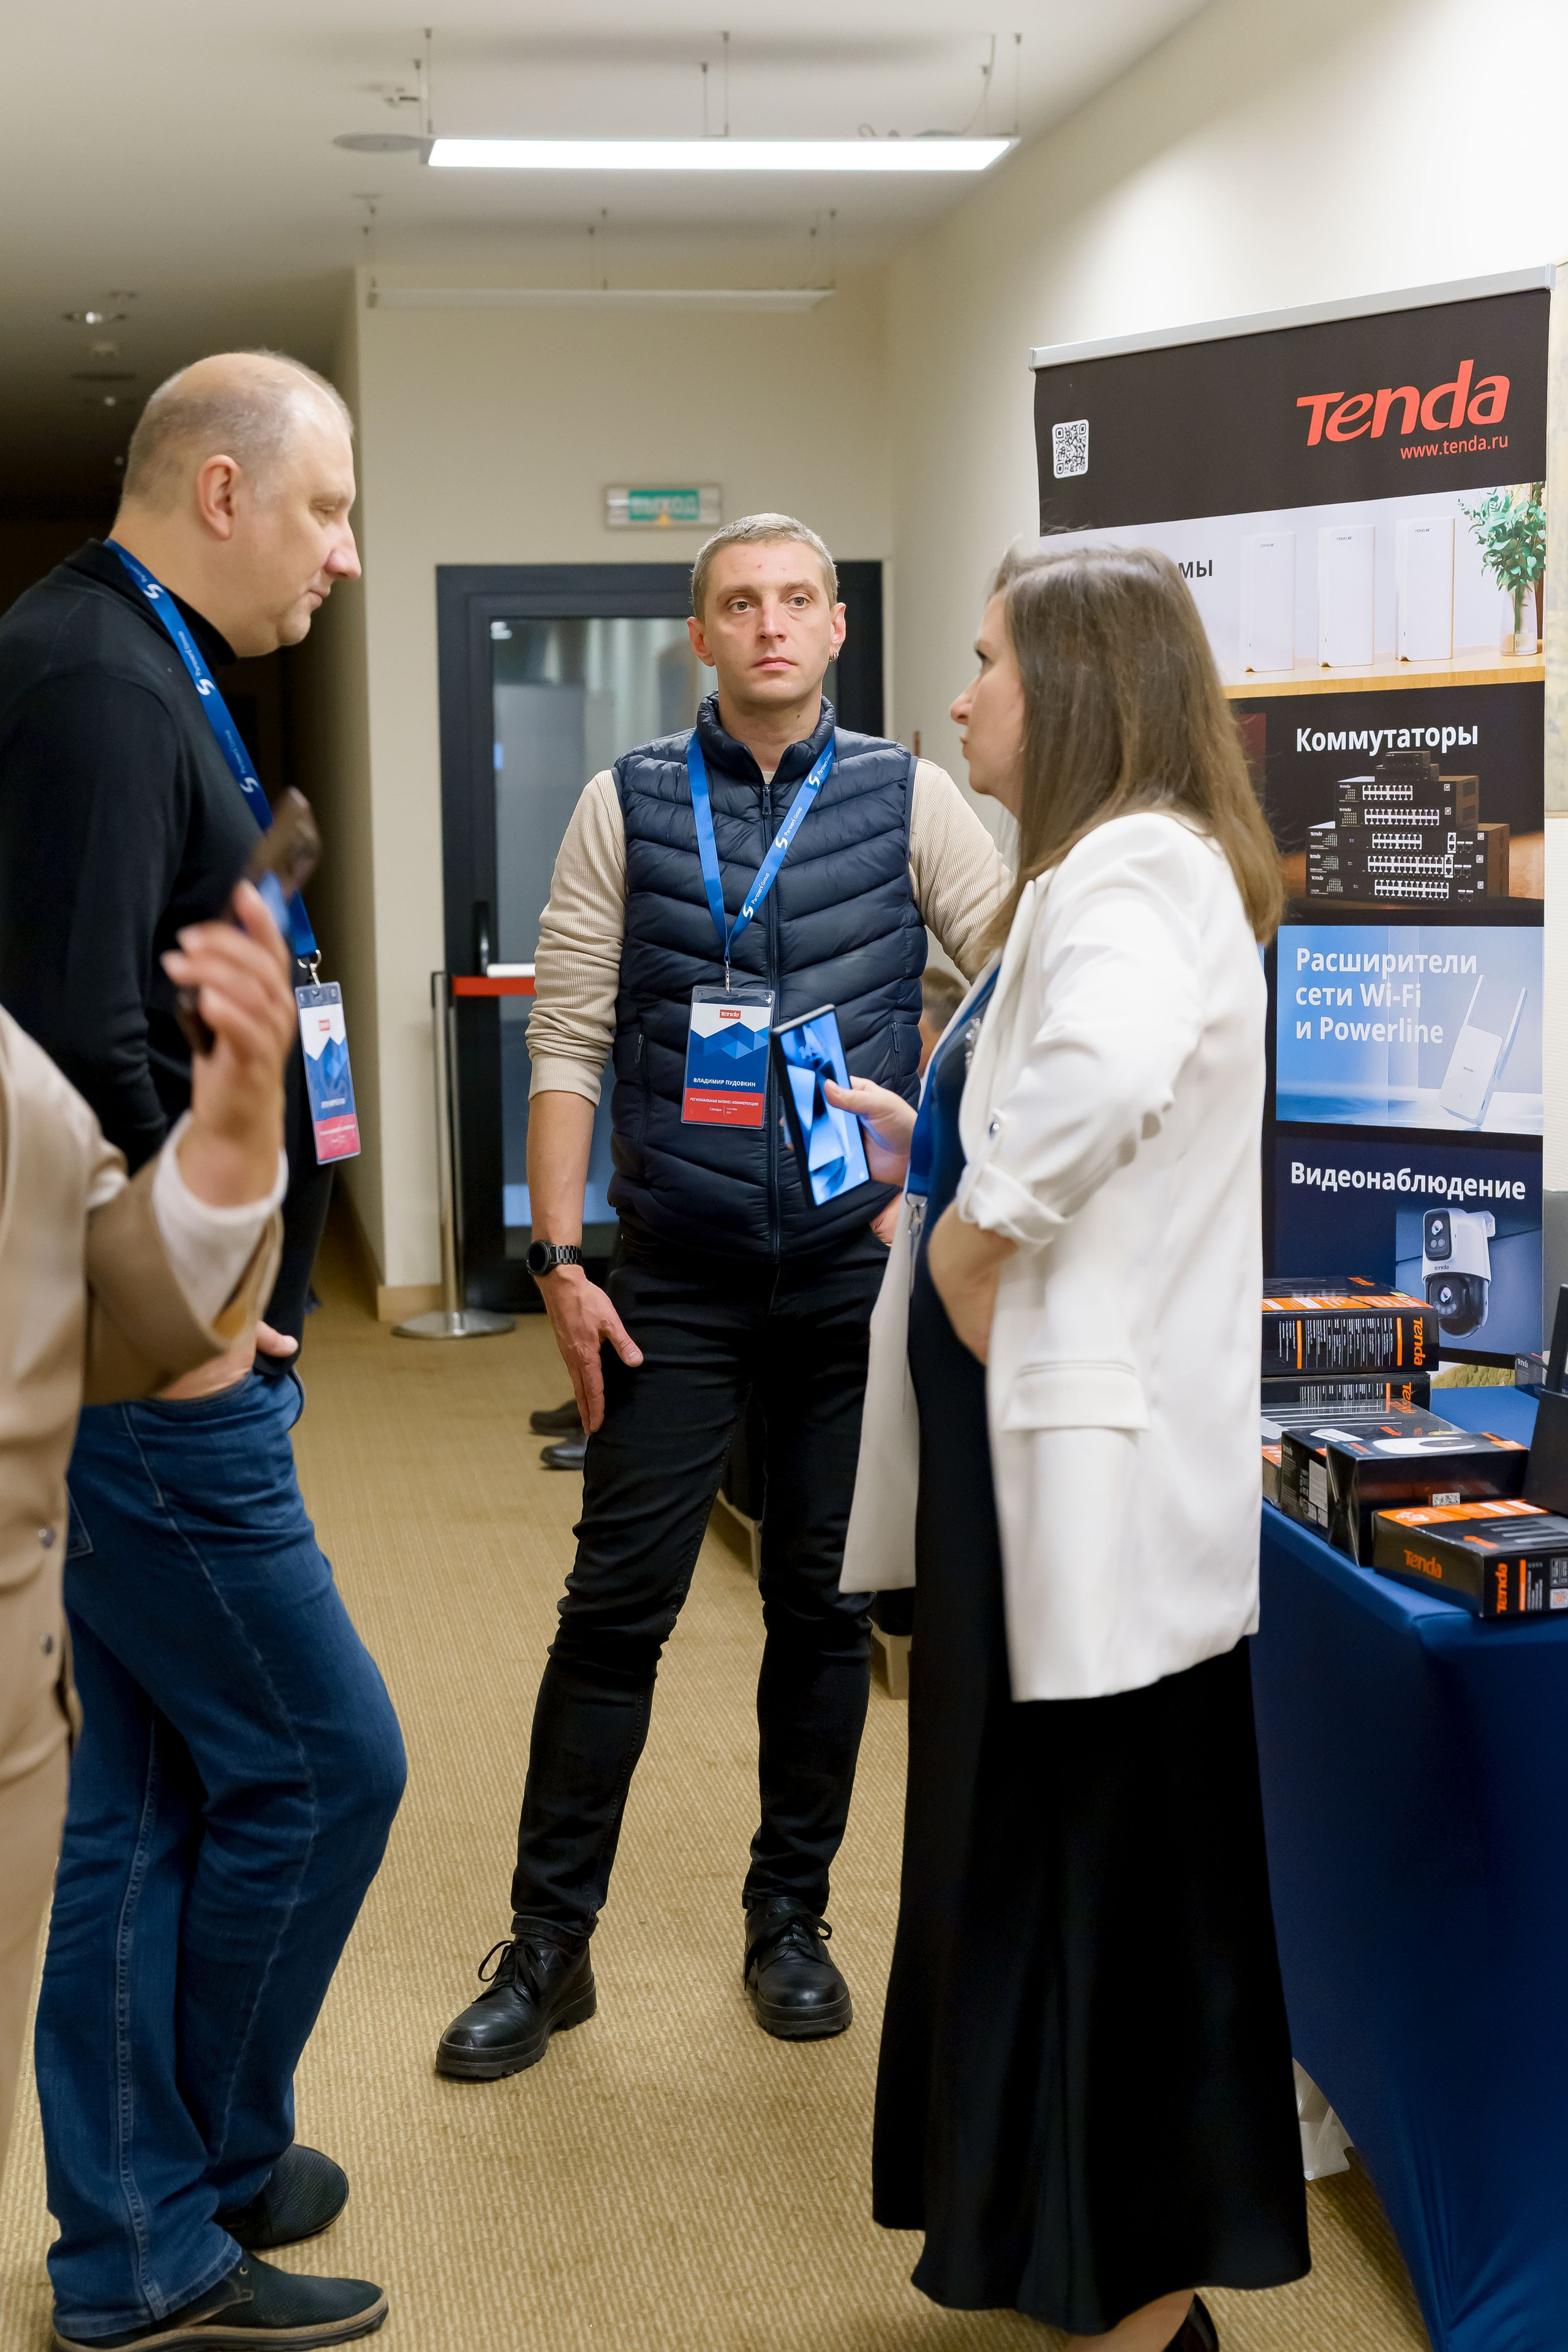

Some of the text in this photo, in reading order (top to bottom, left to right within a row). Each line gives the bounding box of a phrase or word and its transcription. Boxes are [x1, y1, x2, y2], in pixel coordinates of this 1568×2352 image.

[1297, 359, 1510, 446] Tenda
[1400, 435, 1509, 459] www.tenda.ru
[1297, 725, 1478, 756] Коммутаторы
[761, 872, 771, 886] Group
[1297, 948, 1477, 980] Расширители
[1295, 982, 1421, 1008] сети Wi-Fi
[1296, 1016, 1444, 1044] и Powerline
[1291, 1162, 1526, 1201] Видеонаблюдение
[1413, 1317, 1426, 1366] Tenda
[1404, 1550, 1442, 1578] Tenda
[1495, 1563, 1507, 1613] Tenda
